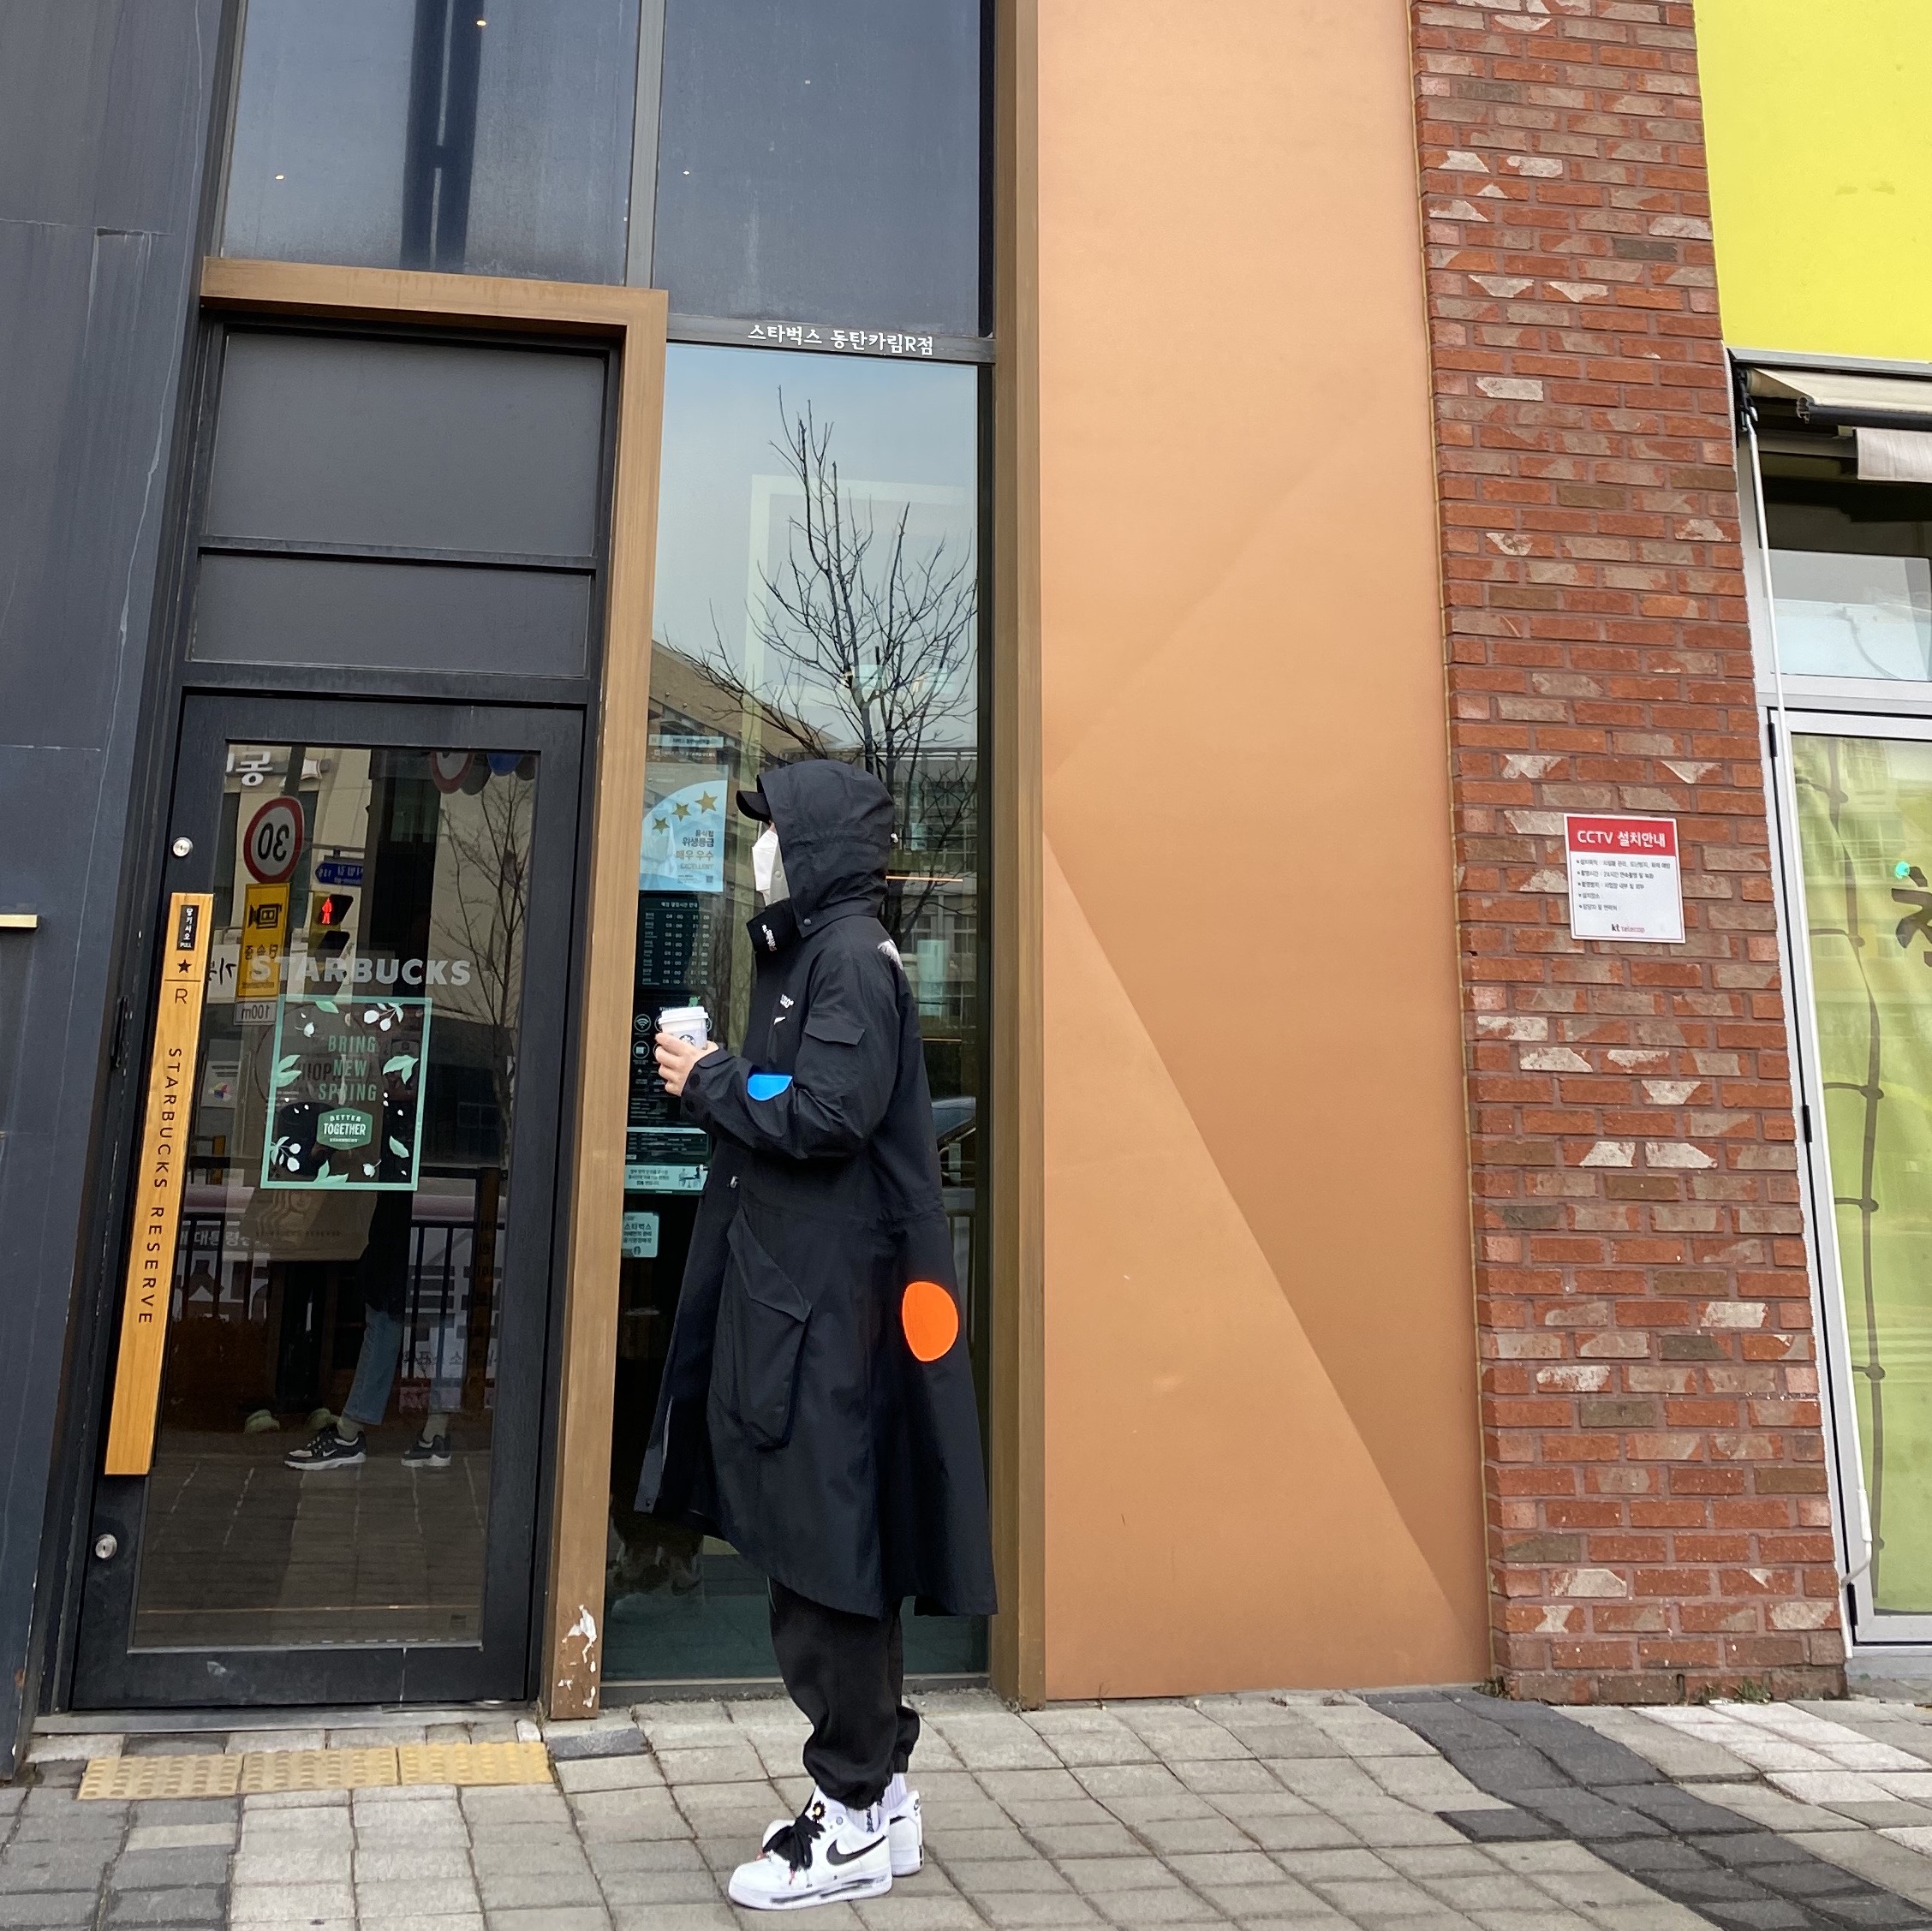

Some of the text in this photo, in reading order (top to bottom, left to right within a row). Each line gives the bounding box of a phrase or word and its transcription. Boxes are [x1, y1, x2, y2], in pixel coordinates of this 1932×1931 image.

[748, 325, 933, 356] 스타벅스 동탄카림R점
[695, 829, 714, 837] 음식점
[1577, 830, 1666, 848] CCTV 설치안내
[682, 837, 714, 848] 위생등급
[696, 850, 714, 861] 우수
[183, 908, 194, 940] 당기시오
[1611, 923, 1620, 932] kt
[250, 956, 472, 986] STARBUCKS
[174, 988, 188, 1004] R
[328, 1035, 377, 1053] BRING
[333, 1059, 367, 1077] NEW
[318, 1083, 377, 1101] SPRING
[330, 1114, 361, 1123] BETTER
[323, 1123, 367, 1135] TOGETHER
[138, 1047, 182, 1325] STARBUCKS RESERVE
